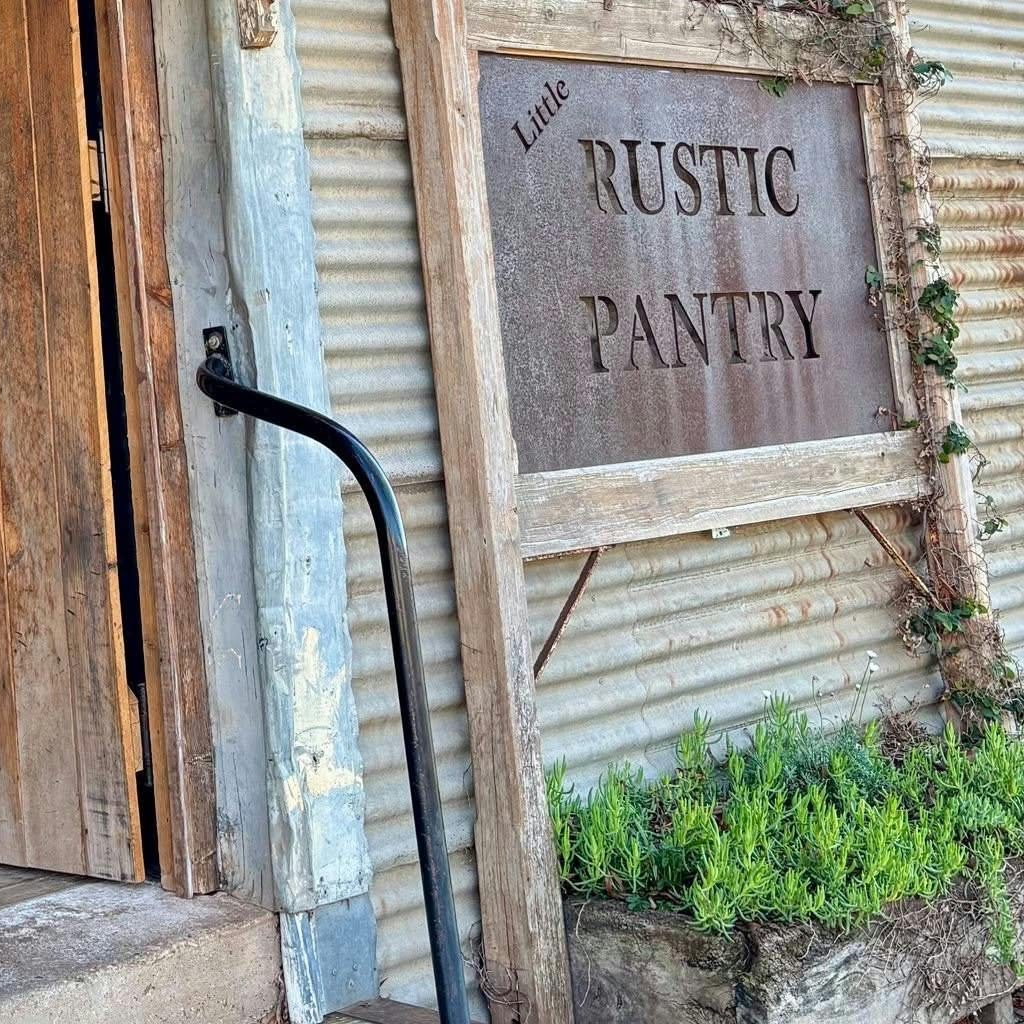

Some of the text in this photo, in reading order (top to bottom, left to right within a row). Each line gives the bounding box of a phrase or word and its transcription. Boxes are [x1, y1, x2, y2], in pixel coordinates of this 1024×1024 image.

[510, 77, 570, 154] Little
[577, 138, 800, 217] RUSTIC
[579, 289, 822, 373] PANTRY
